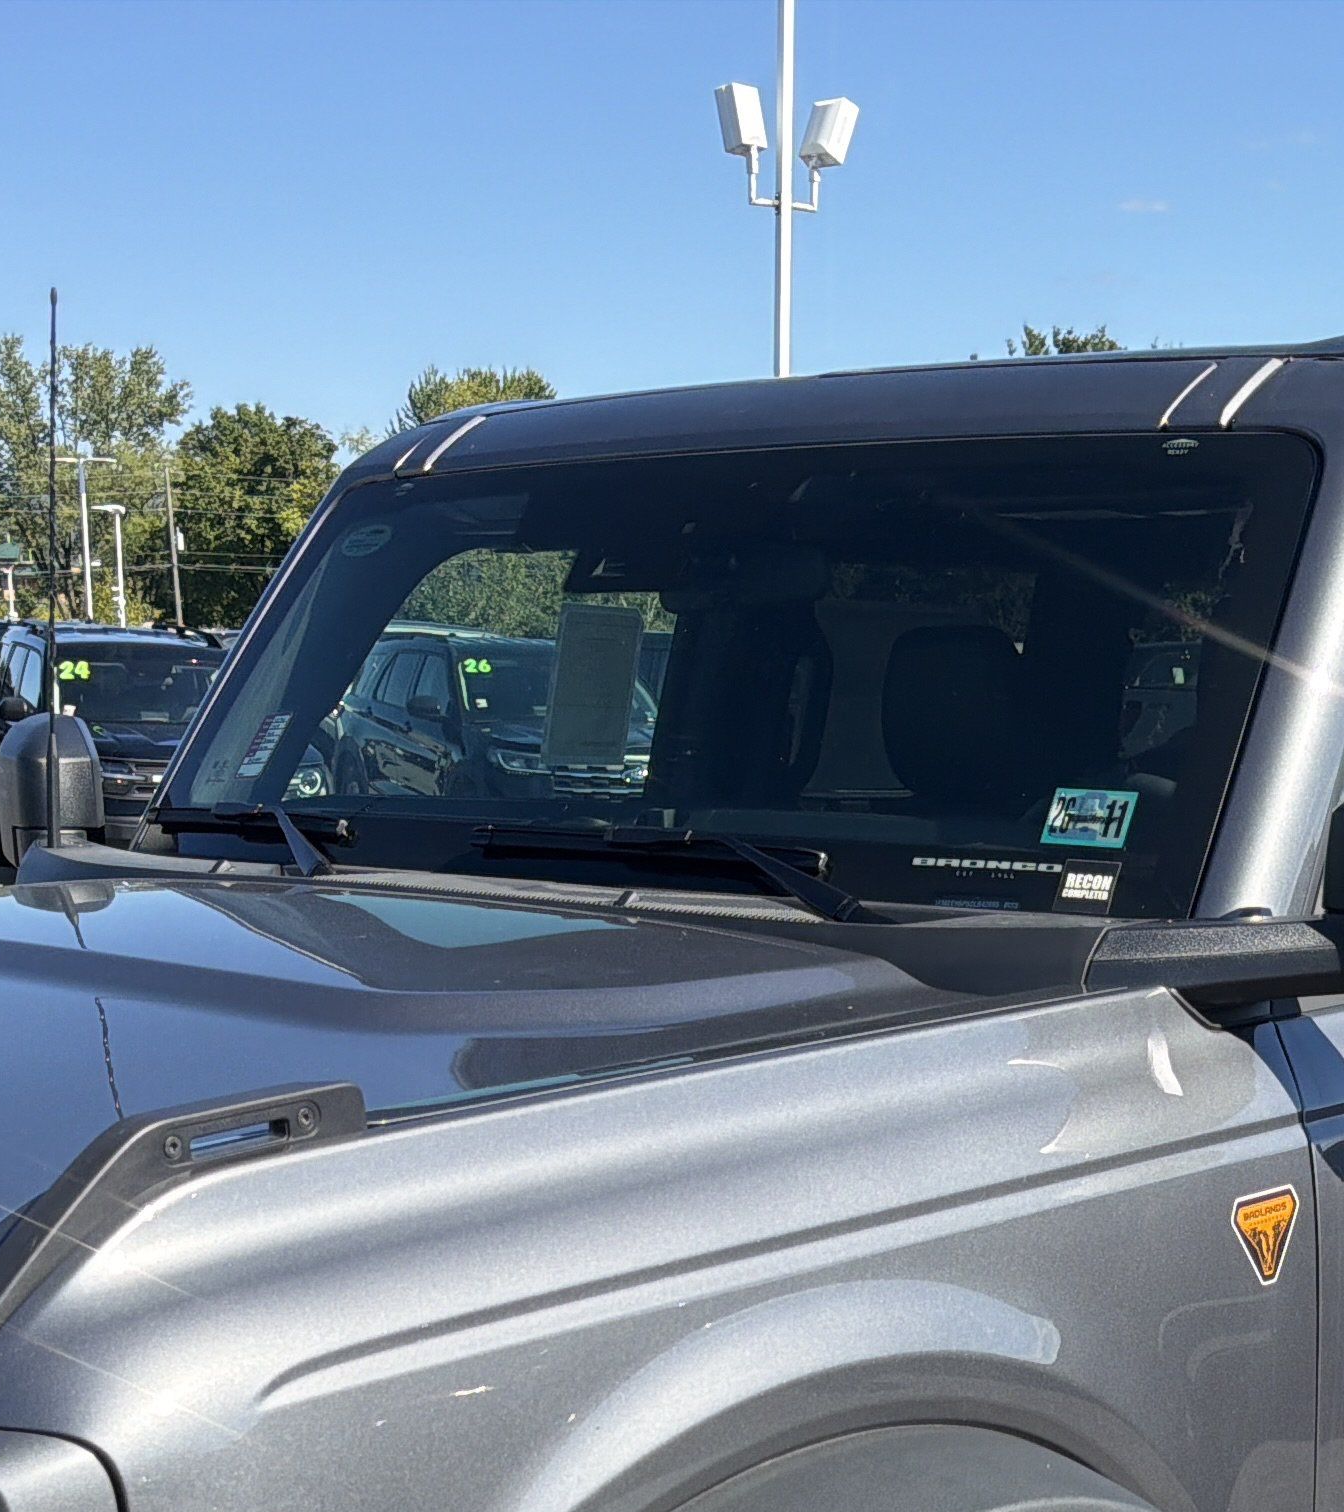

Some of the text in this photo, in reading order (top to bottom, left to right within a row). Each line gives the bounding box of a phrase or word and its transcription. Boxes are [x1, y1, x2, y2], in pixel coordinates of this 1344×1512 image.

[58, 660, 91, 681] 24
[463, 657, 493, 674] 26
[1099, 799, 1130, 839] 11
[911, 856, 1063, 873] BRONCO
[1064, 872, 1114, 891] RECON
[1061, 887, 1109, 901] COMPLETED
[1243, 1201, 1288, 1222] BADLANDS
